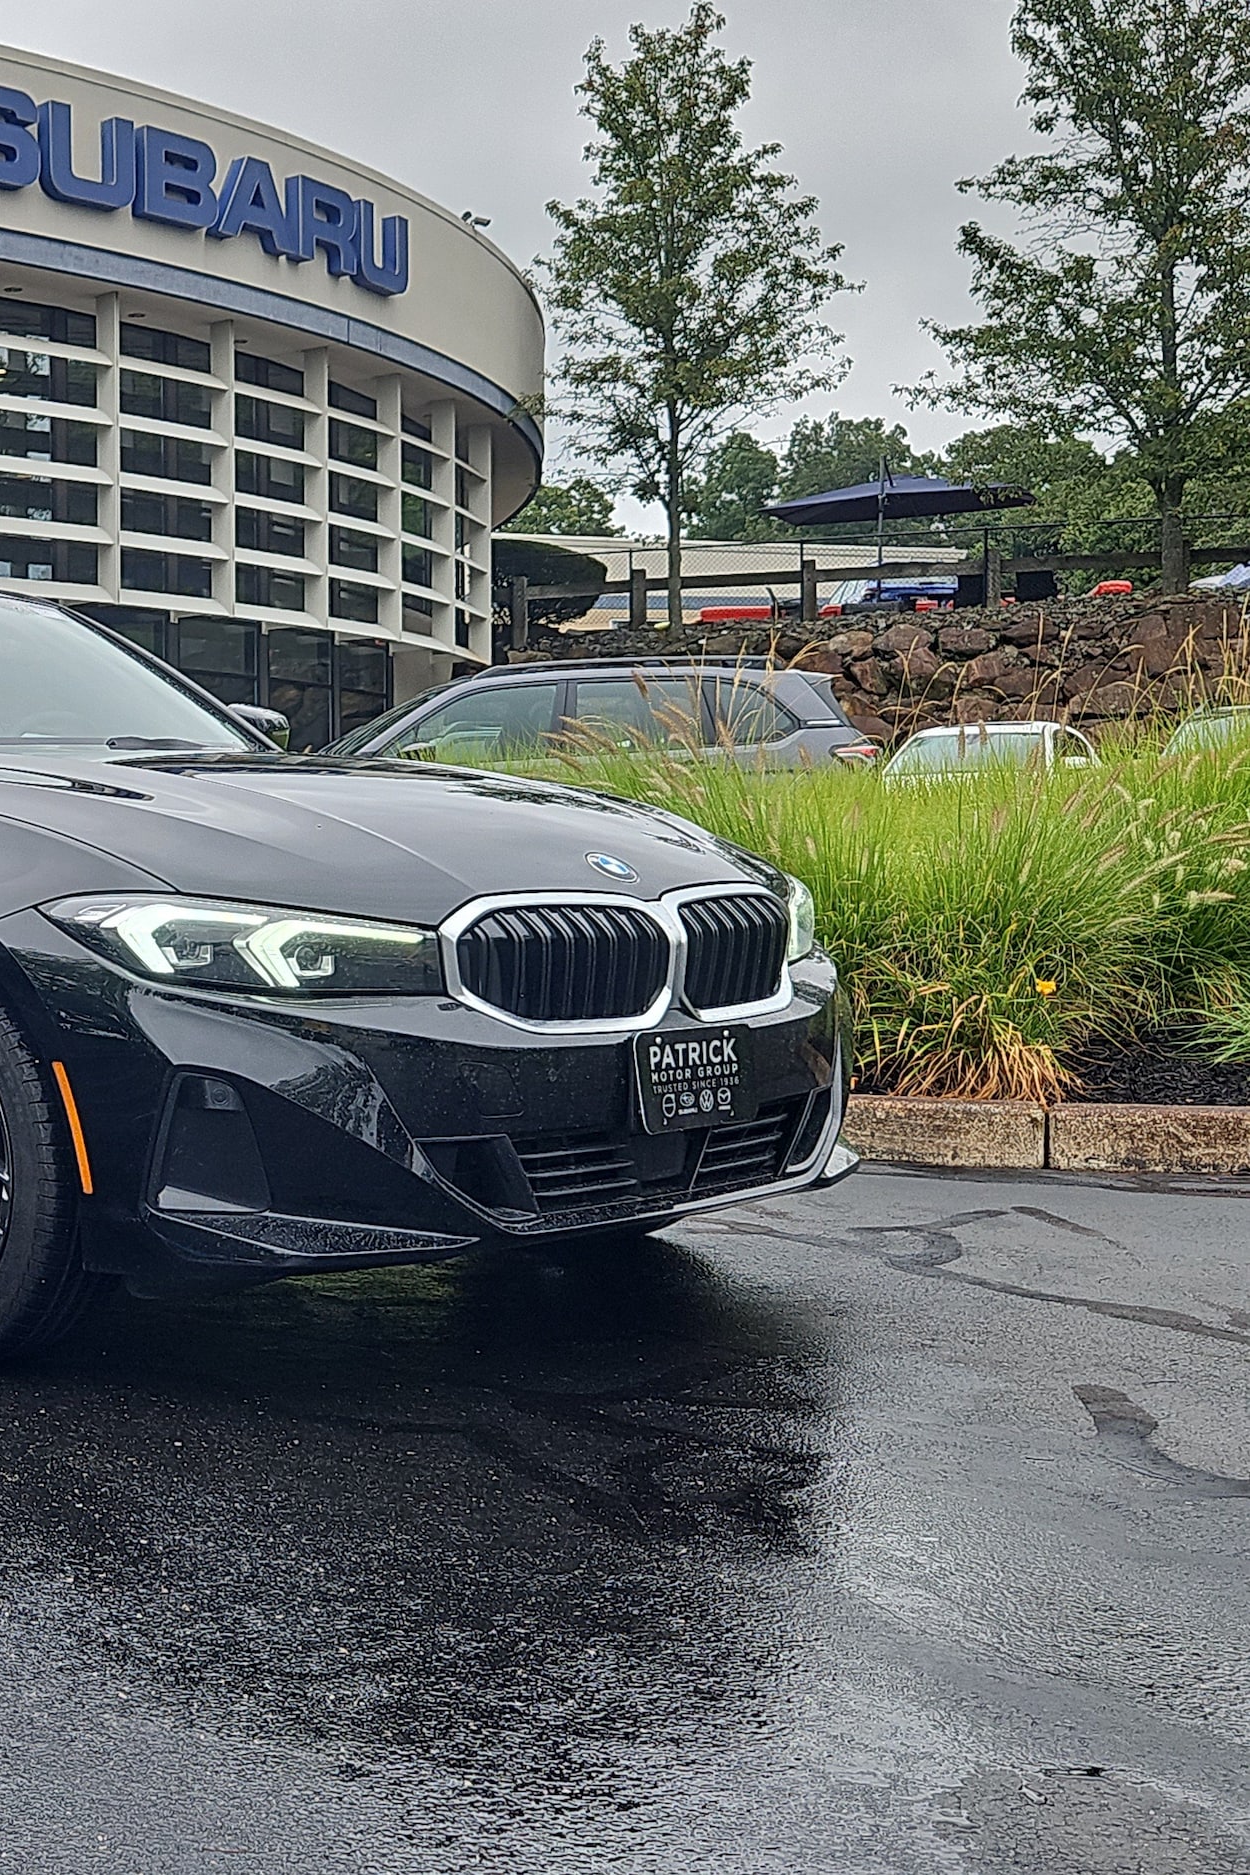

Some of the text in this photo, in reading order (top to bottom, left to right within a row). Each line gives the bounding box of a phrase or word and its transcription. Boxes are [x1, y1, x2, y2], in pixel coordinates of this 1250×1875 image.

[649, 1037, 738, 1070] PATRICK
[651, 1063, 739, 1083] MOTOR GROUP
[652, 1082, 689, 1095] TRUSTED
[691, 1078, 717, 1090] SINCE
